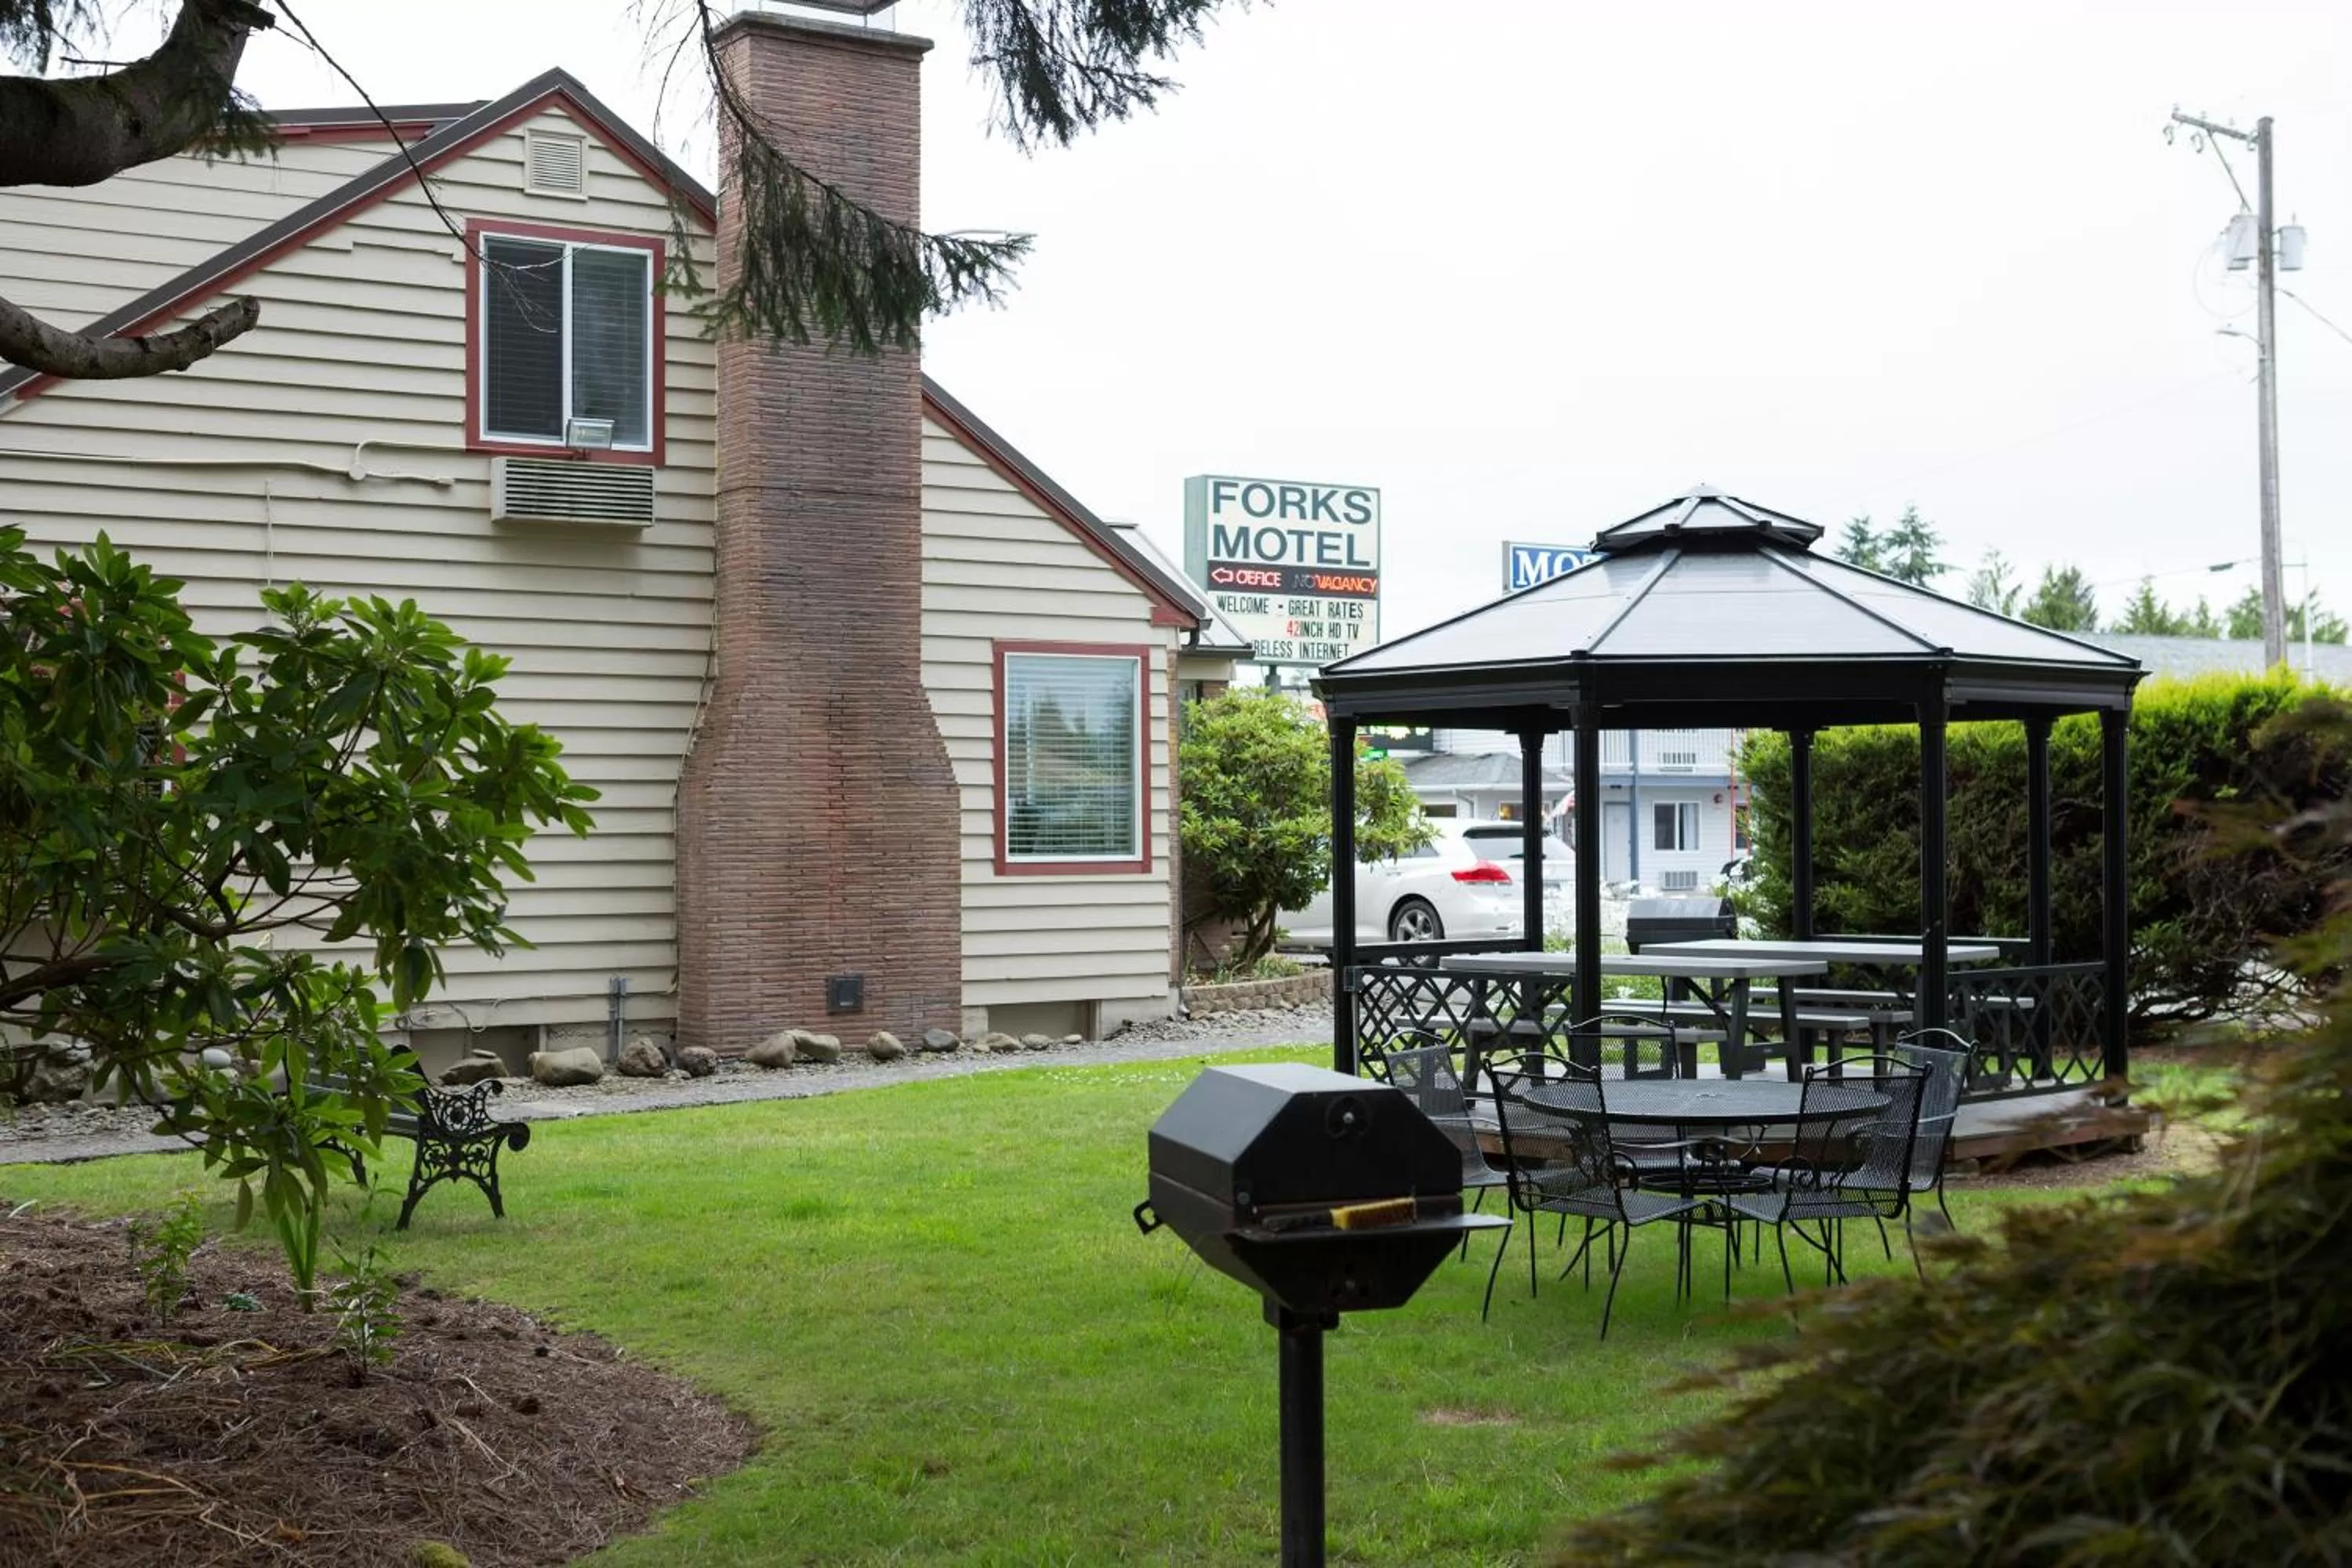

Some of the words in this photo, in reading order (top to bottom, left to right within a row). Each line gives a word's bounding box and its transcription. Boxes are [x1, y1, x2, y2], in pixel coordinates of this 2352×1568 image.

[1213, 481, 1372, 524] FORKS
[1213, 524, 1370, 567] MOTEL
[1236, 570, 1282, 586] OFFICE
[1515, 550, 1605, 586] MO
[1292, 574, 1316, 589] NO
[1315, 574, 1377, 593] VACANCY
[1217, 595, 1269, 615] WELCOME
[1288, 600, 1320, 617] GREAT
[1328, 601, 1364, 619] RATES
[1328, 622, 1341, 638] HD
[1347, 622, 1359, 640] TV
[1299, 641, 1349, 659] INTERNET
